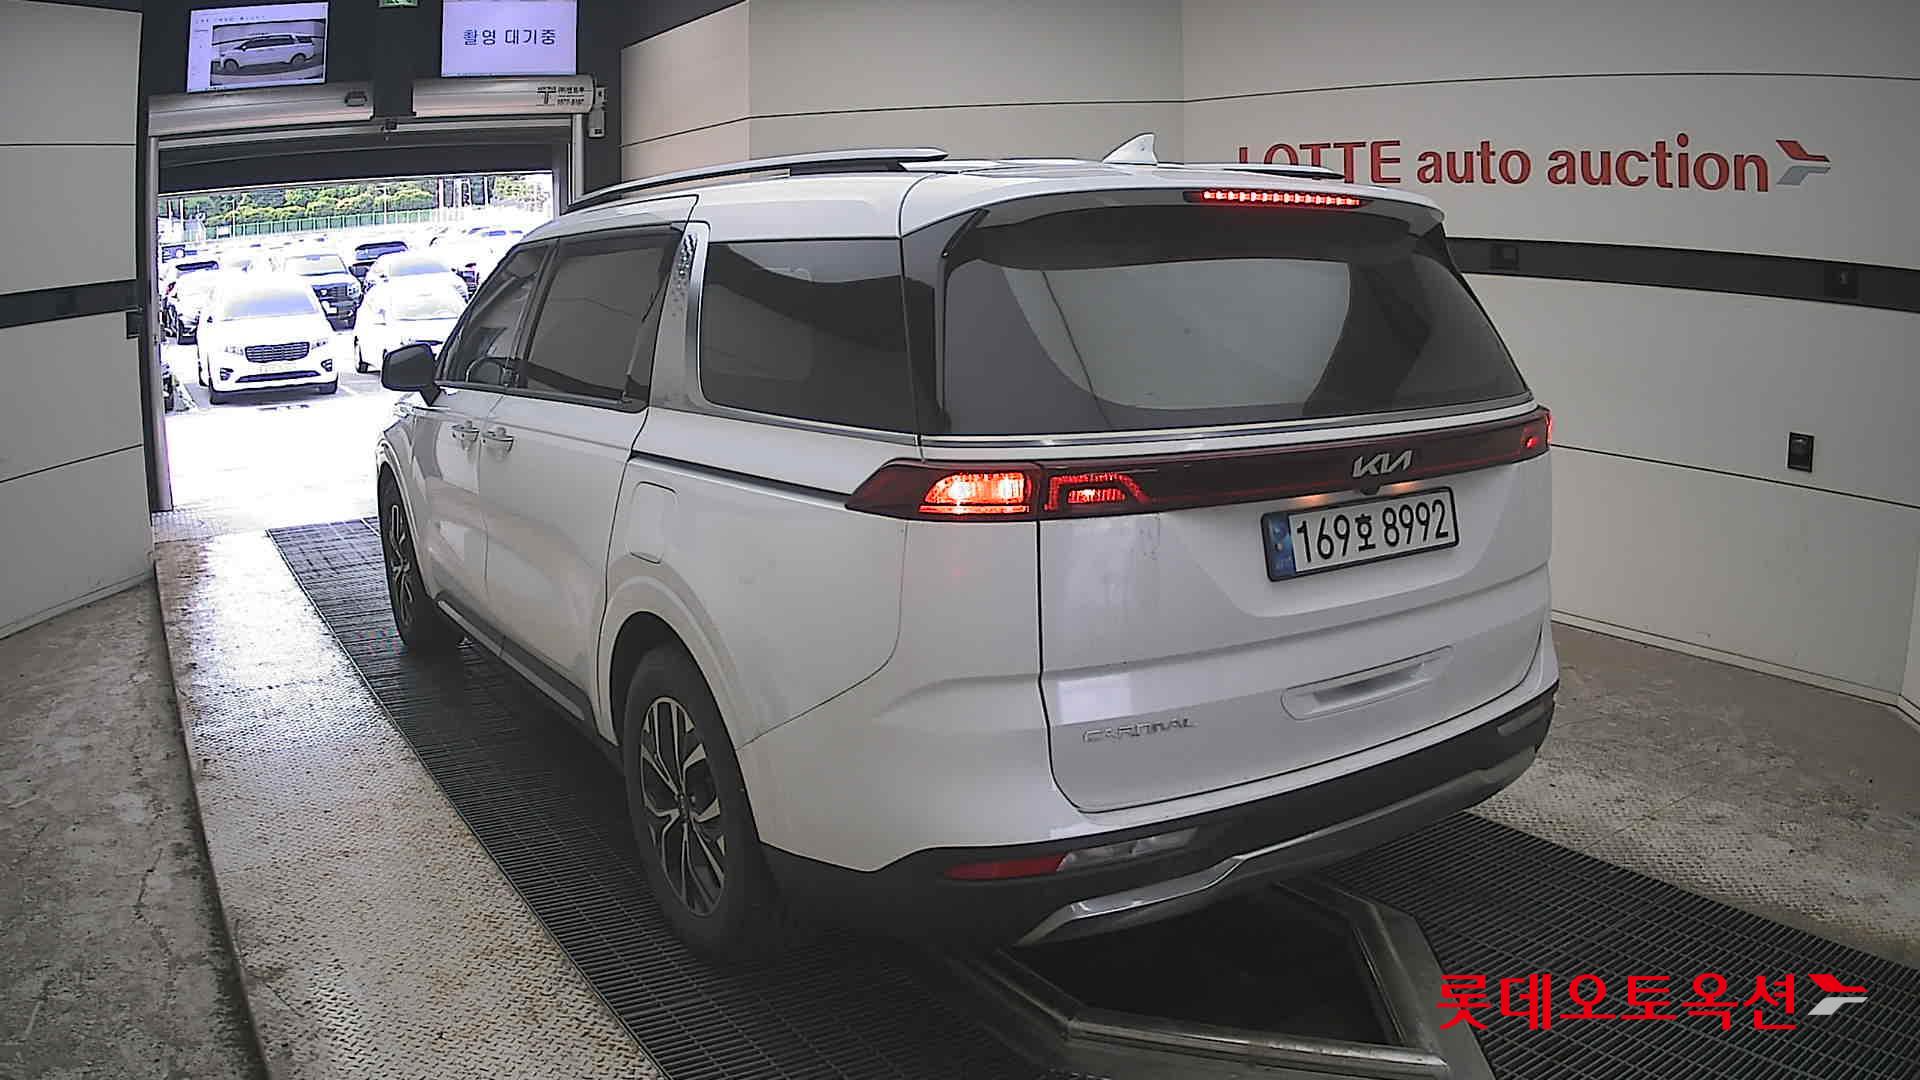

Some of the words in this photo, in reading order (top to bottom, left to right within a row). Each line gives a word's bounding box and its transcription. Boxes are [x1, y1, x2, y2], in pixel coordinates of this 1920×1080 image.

[504, 29, 556, 45] 대기중
[1417, 139, 1532, 185] auto
[1547, 132, 1770, 193] auction
[1296, 514, 1376, 563] 169호
[1382, 499, 1449, 547] 8992
